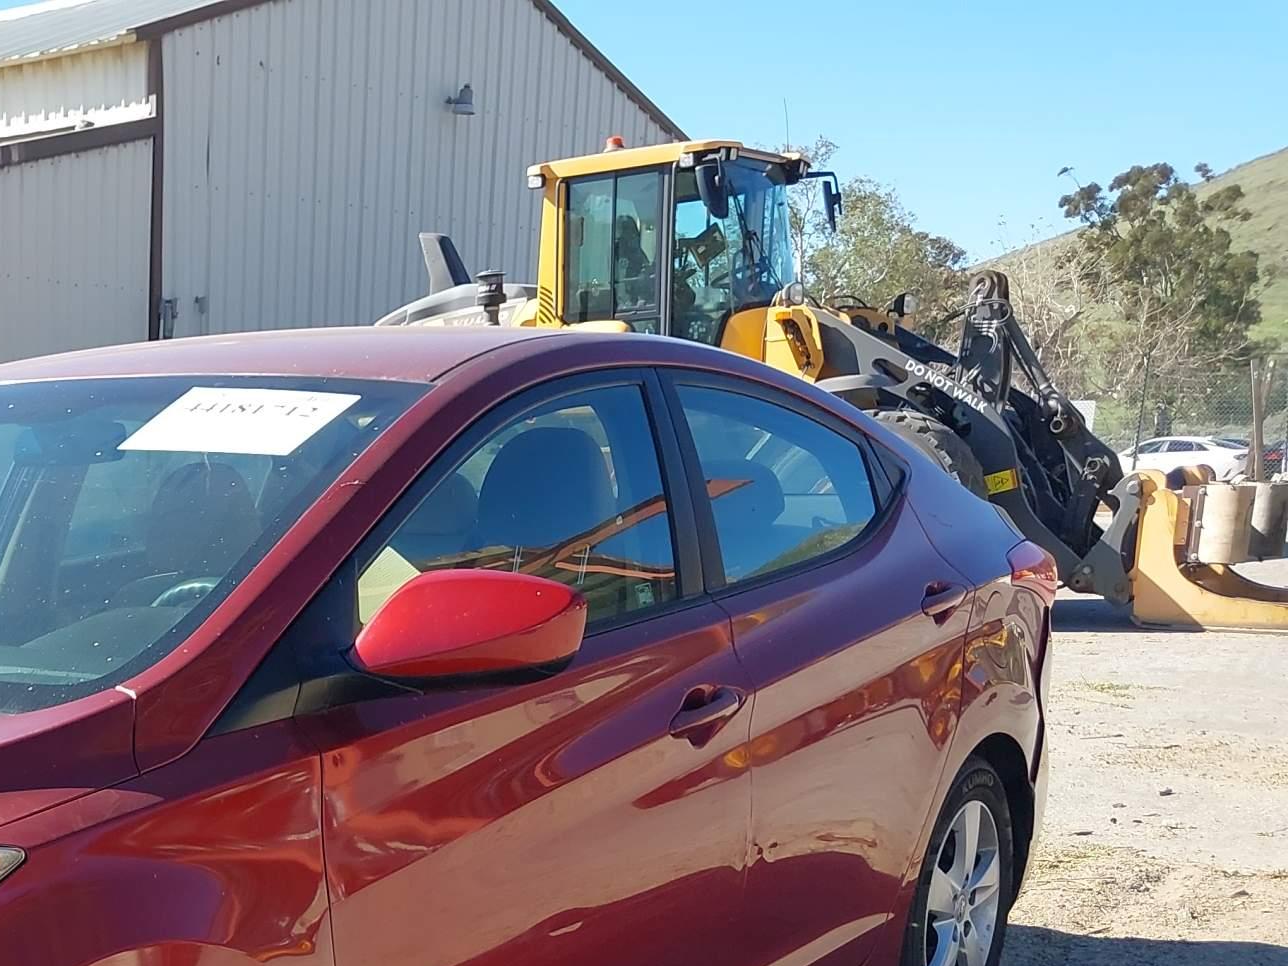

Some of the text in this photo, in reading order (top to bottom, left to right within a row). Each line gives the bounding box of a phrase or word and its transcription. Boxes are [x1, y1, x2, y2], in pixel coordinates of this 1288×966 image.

[905, 359, 988, 413] DO NOT WALK
